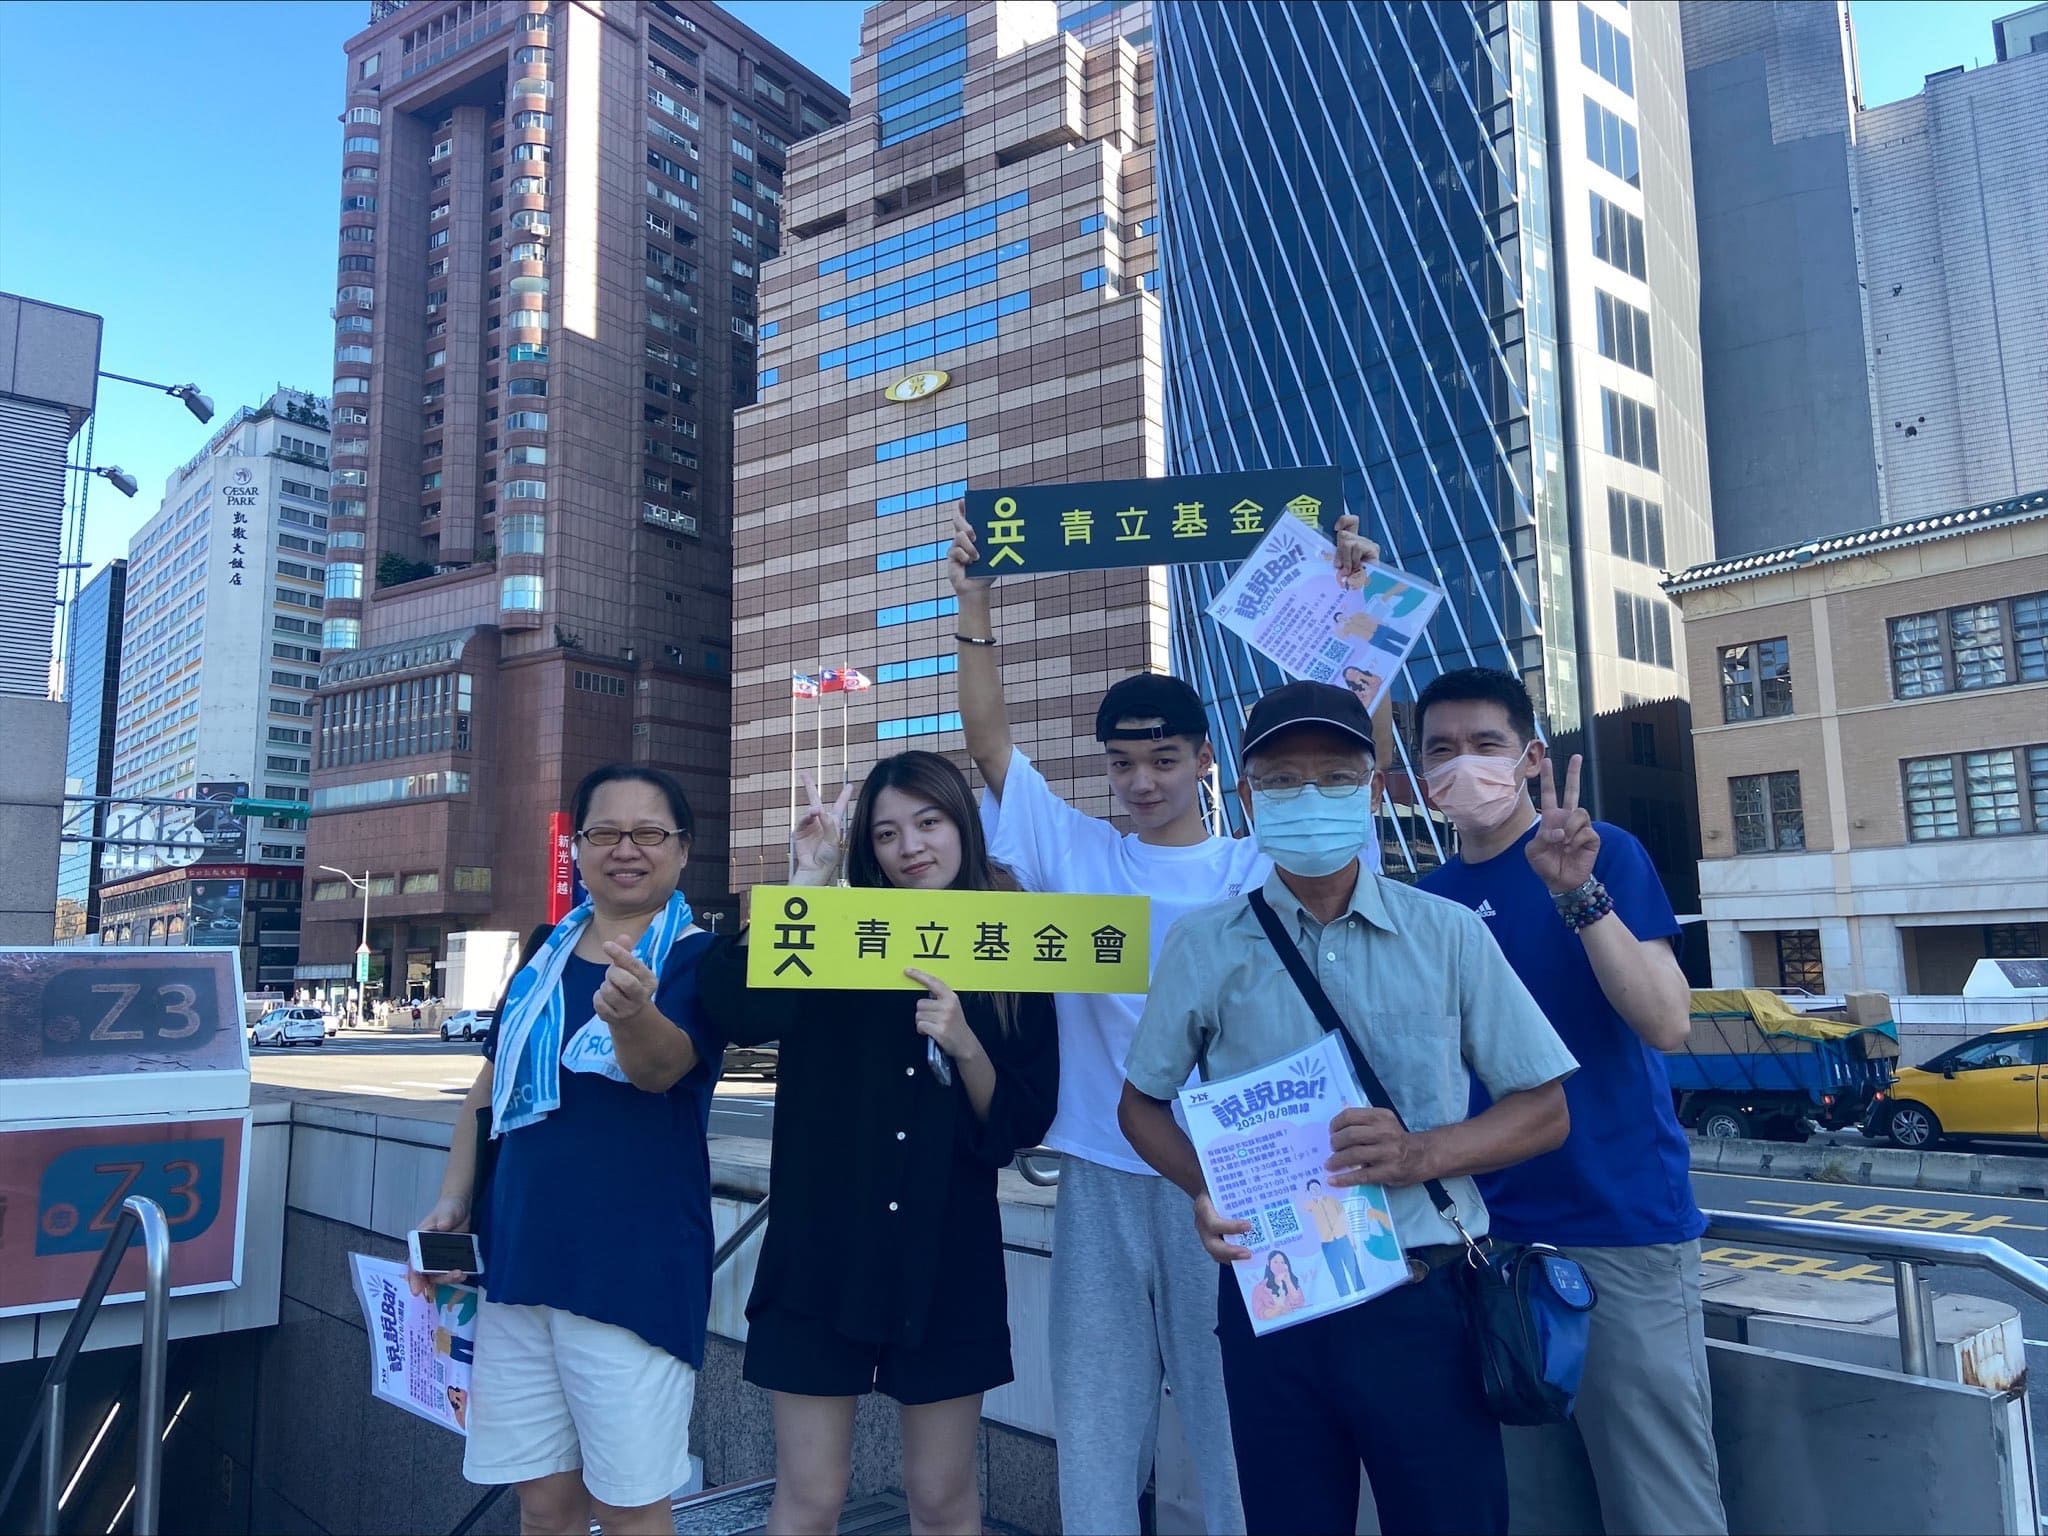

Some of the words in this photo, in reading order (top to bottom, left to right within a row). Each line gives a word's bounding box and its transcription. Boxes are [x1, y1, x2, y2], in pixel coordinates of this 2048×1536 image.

[227, 497, 256, 505] PARK
[1060, 493, 1322, 546] 青立基金會
[556, 835, 569, 895] 新光三越
[854, 918, 1127, 964] 青立基金會
[90, 983, 201, 1041] Z3
[1212, 1076, 1327, 1128] 說說Bar!
[1235, 1103, 1310, 1131] 2023/8/8開線
[87, 1160, 201, 1232] Z3
